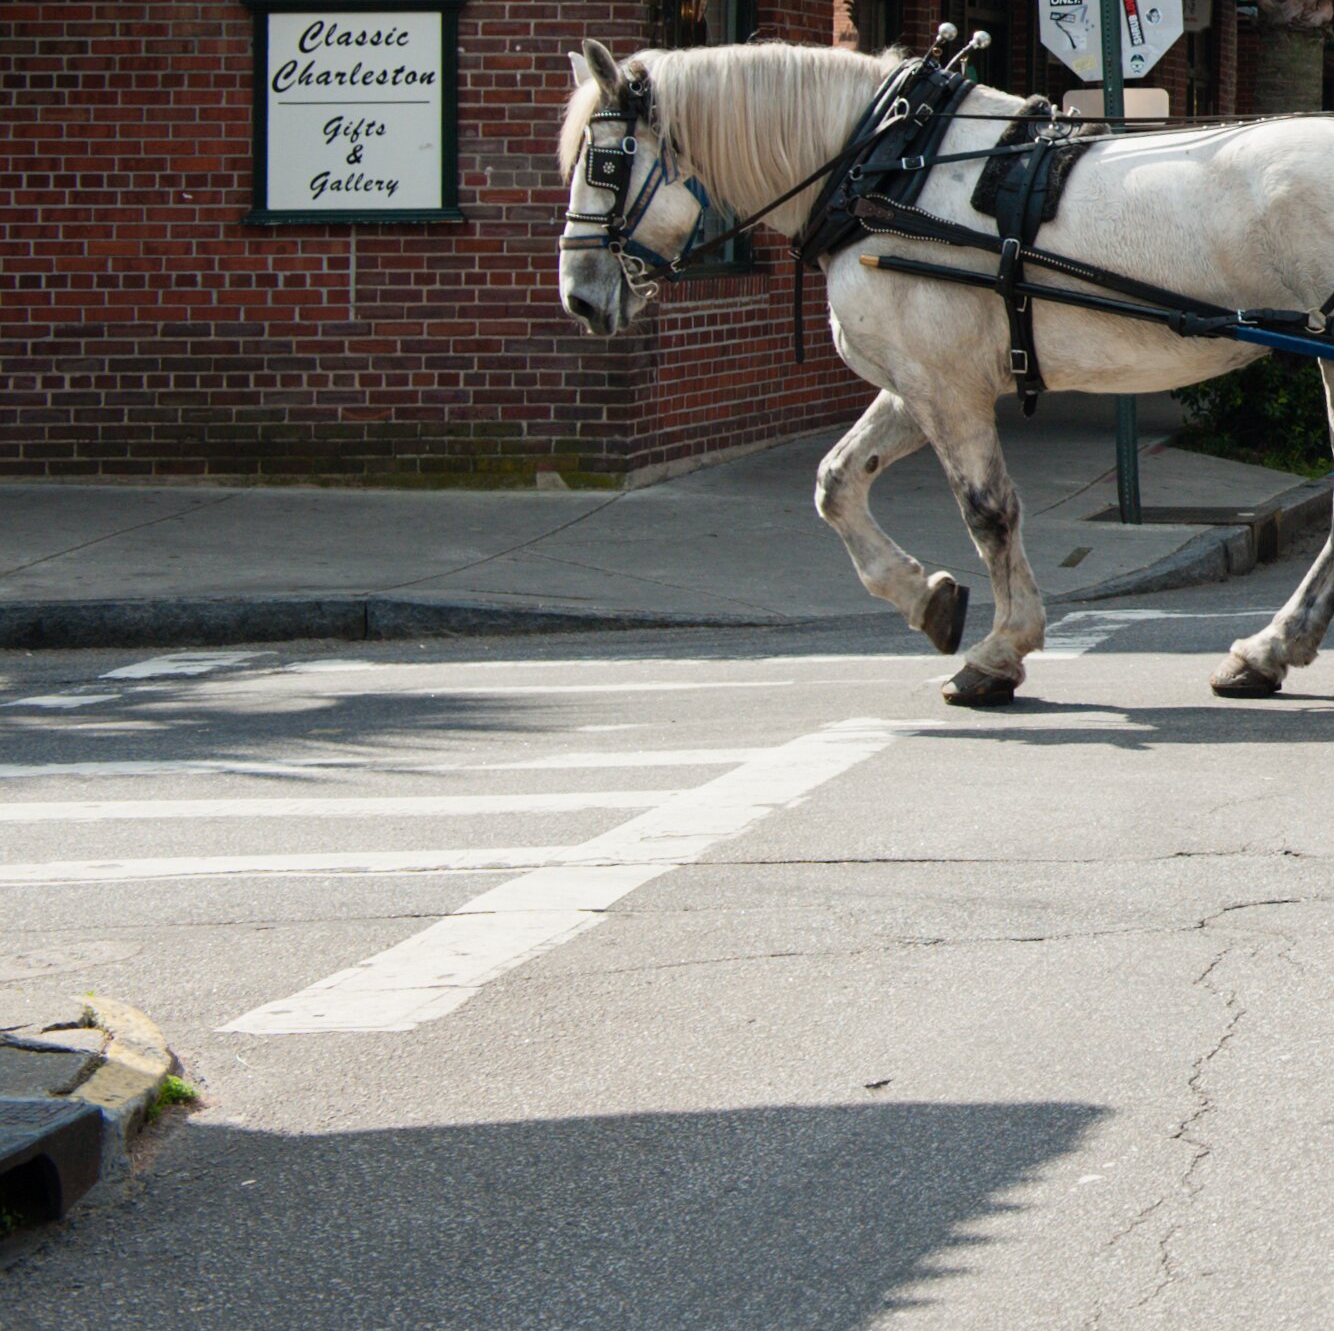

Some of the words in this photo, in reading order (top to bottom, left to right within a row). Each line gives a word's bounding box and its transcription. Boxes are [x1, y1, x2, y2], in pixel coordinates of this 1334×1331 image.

[298, 20, 410, 54] Classic
[271, 59, 437, 93] Charleston
[322, 116, 387, 145] Gifts
[346, 144, 364, 165] &
[309, 171, 400, 200] Gallery
